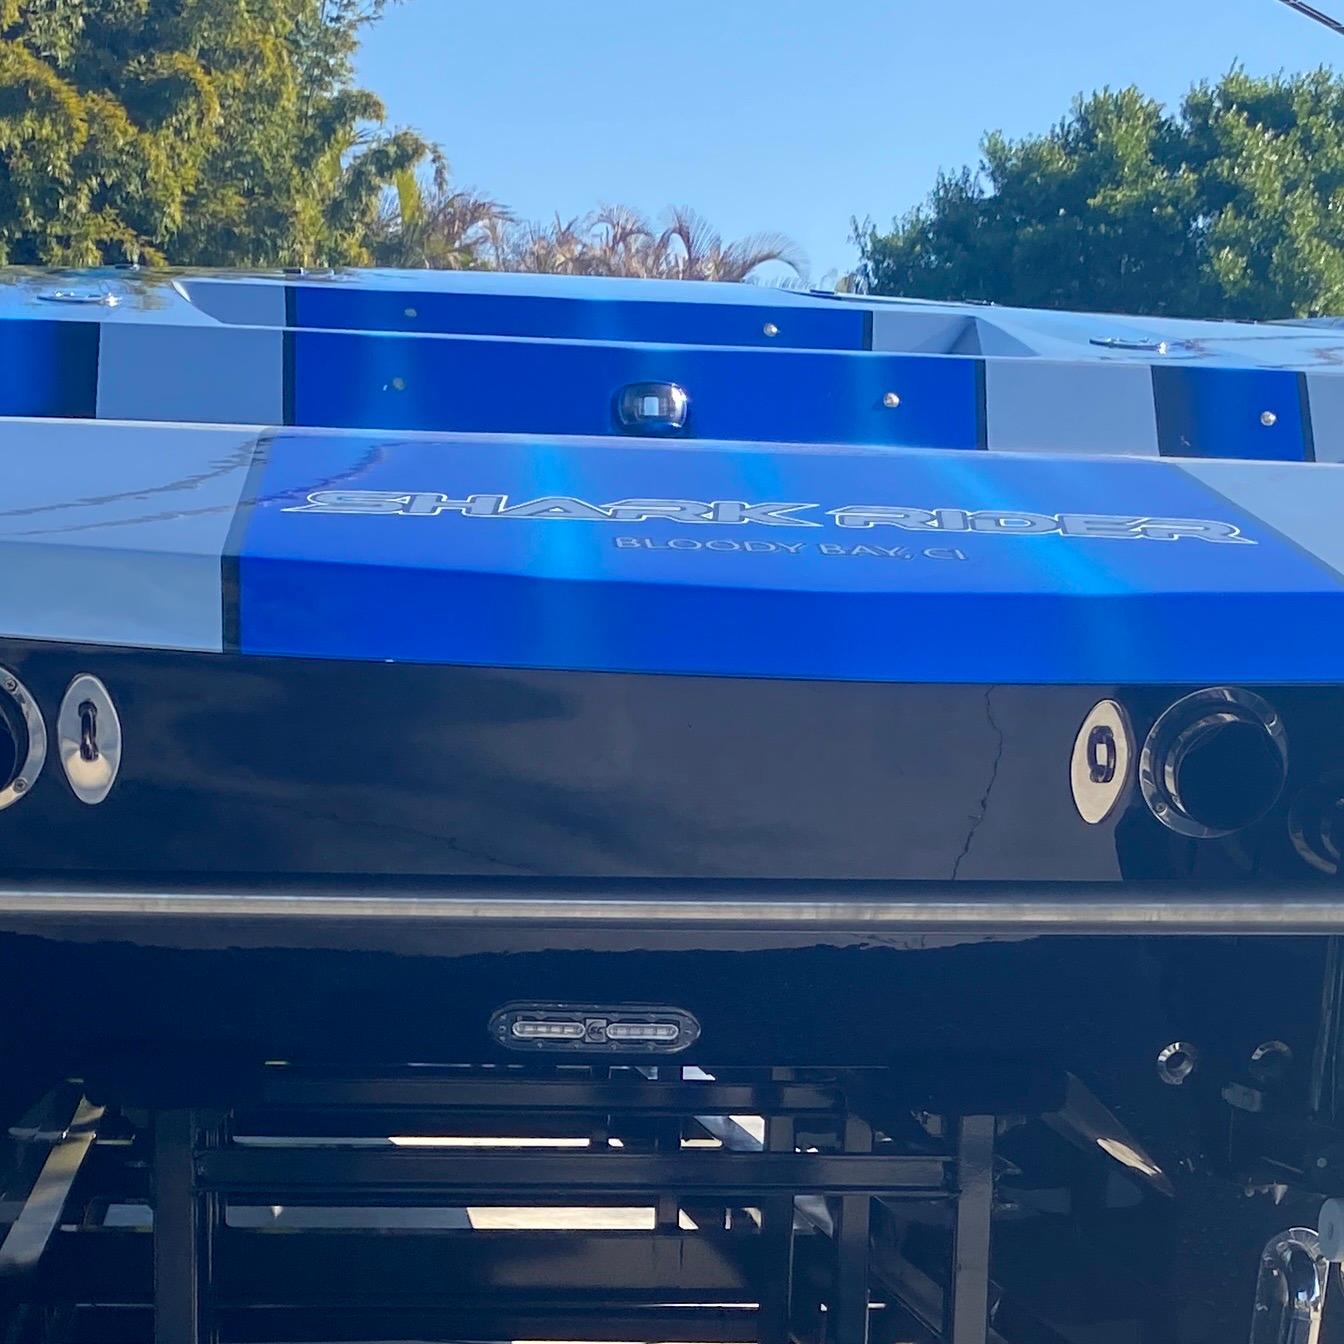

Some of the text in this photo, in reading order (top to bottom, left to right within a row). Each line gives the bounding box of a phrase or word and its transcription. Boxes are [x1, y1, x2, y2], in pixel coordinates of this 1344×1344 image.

[280, 490, 1259, 545] SHARK RIDER
[614, 536, 807, 554] BLOODY
[923, 546, 969, 561] CI
